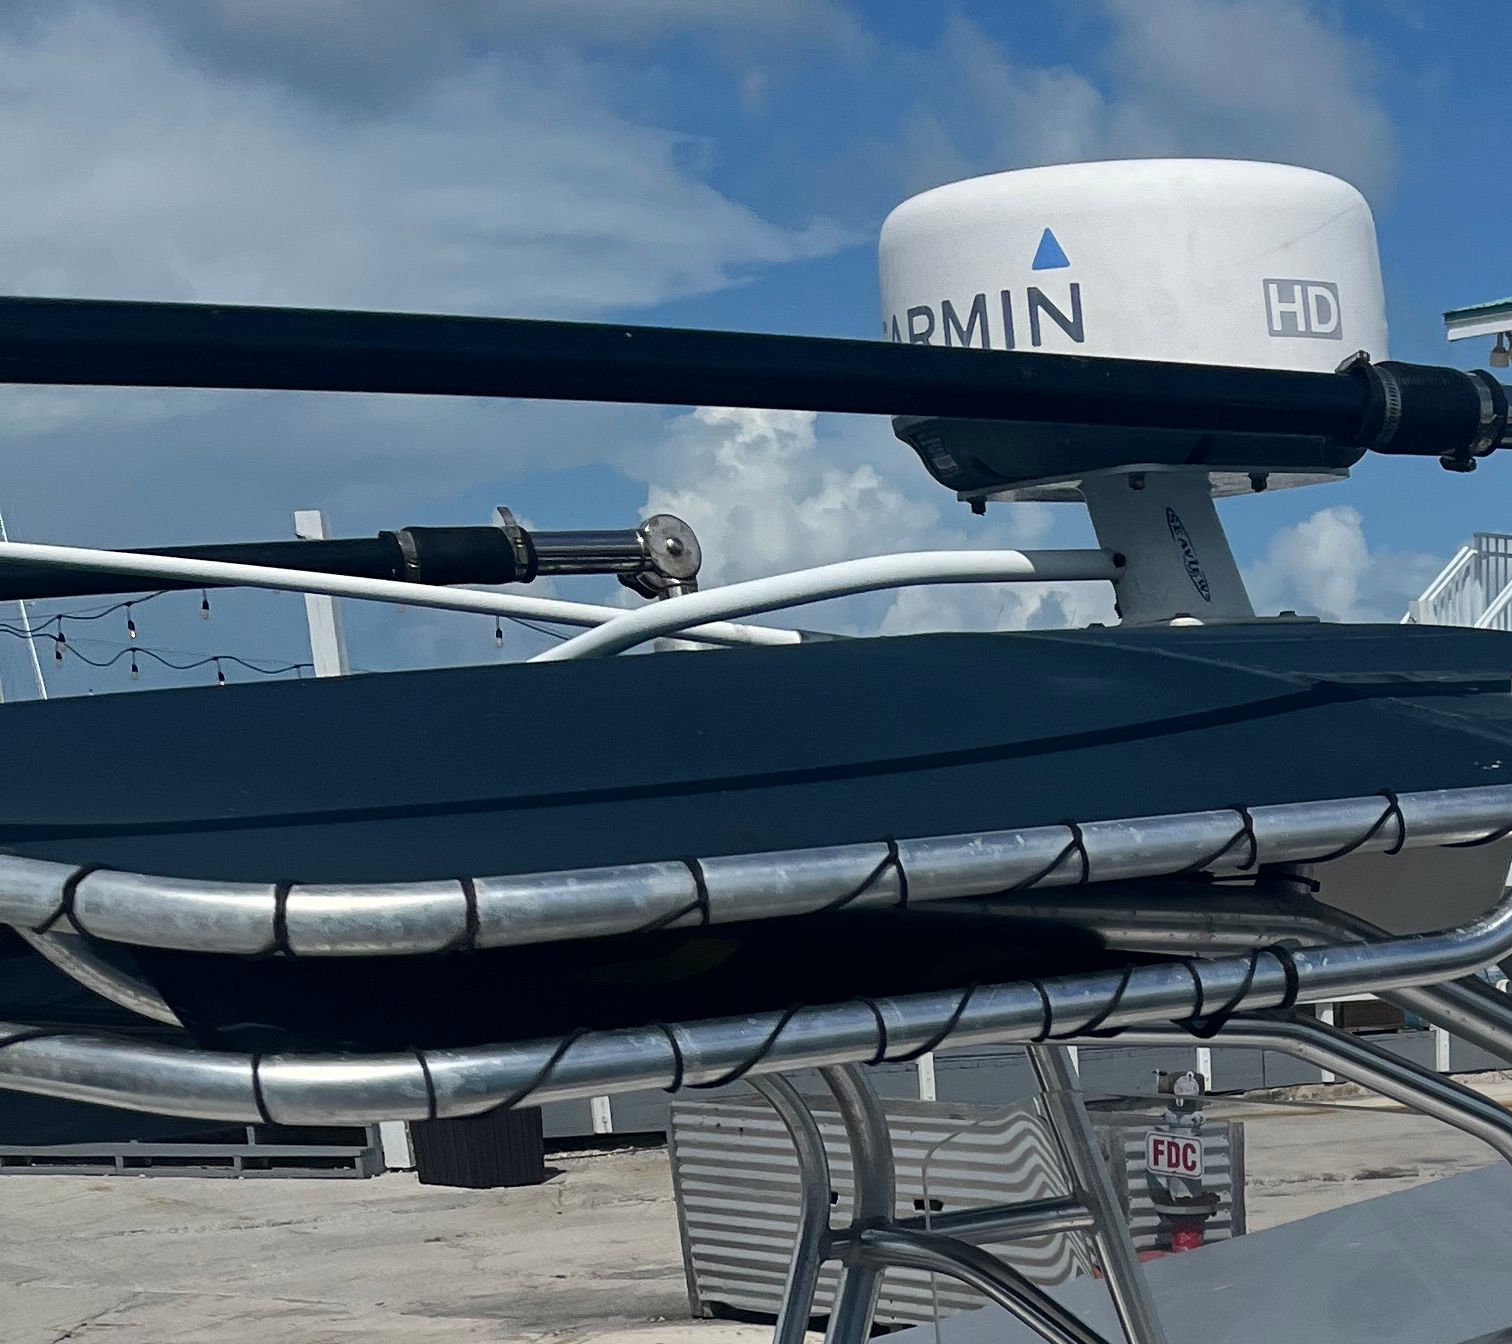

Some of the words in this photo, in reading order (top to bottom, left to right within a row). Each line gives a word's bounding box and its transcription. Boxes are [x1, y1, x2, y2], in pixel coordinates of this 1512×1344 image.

[882, 283, 1084, 350] ARMIN
[1267, 283, 1337, 334] HD
[1153, 1139, 1196, 1172] FDC
